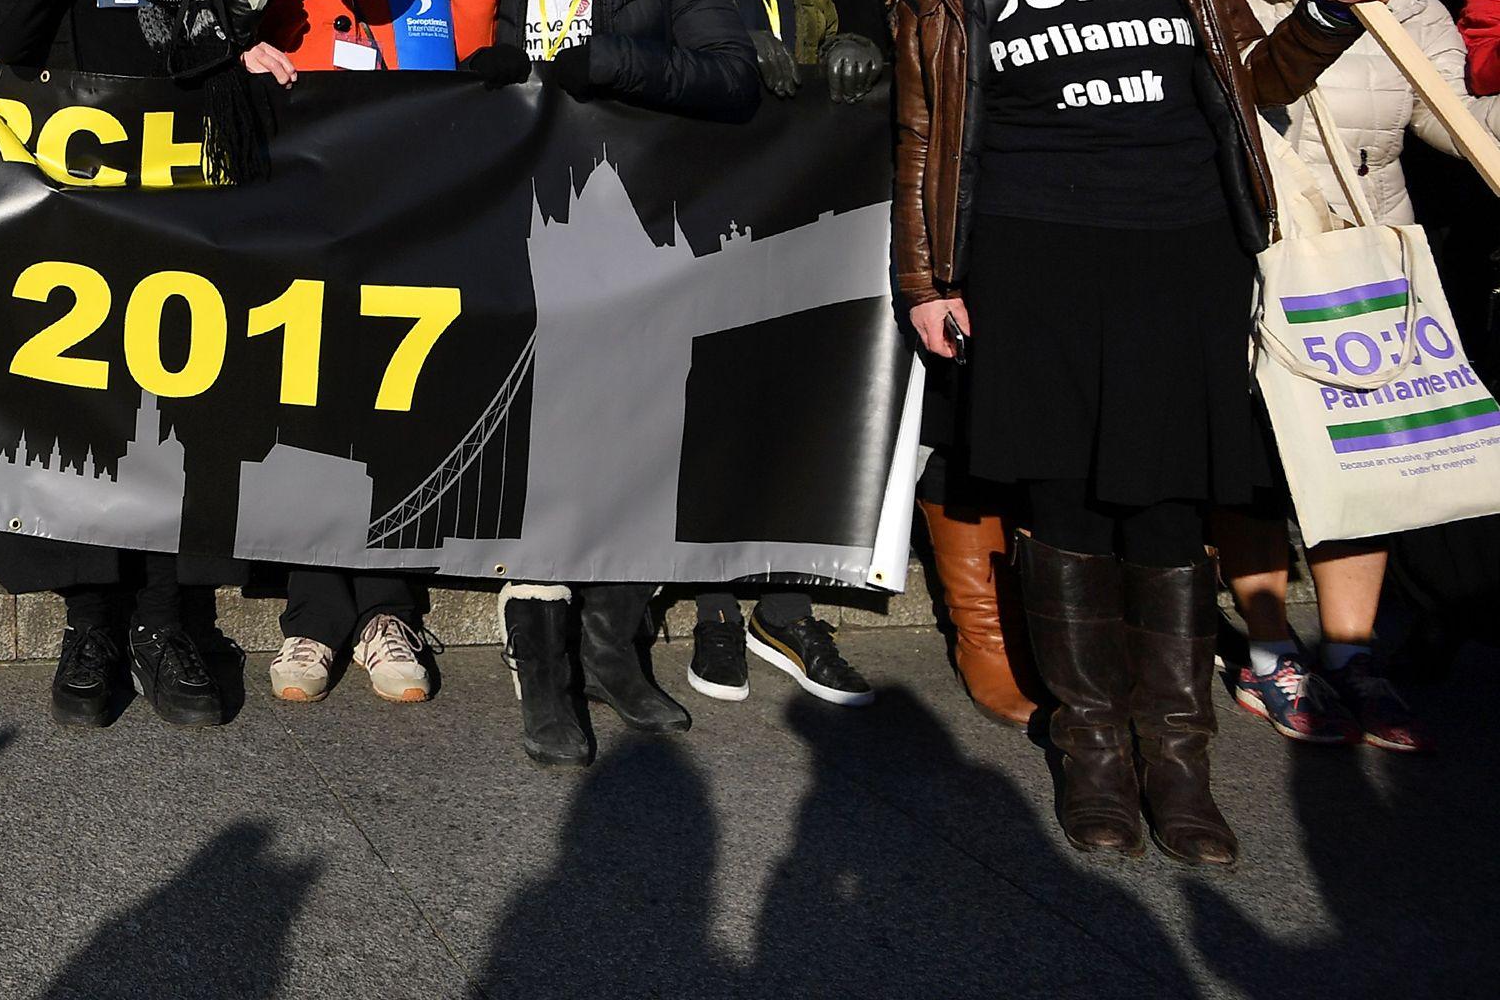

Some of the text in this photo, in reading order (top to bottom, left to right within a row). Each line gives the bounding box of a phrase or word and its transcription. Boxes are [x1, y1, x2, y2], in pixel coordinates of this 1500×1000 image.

[989, 17, 1195, 72] Parliamen
[1056, 69, 1164, 109] .co.uk
[9, 260, 462, 412] 2017
[1320, 363, 1477, 410] Parliament
